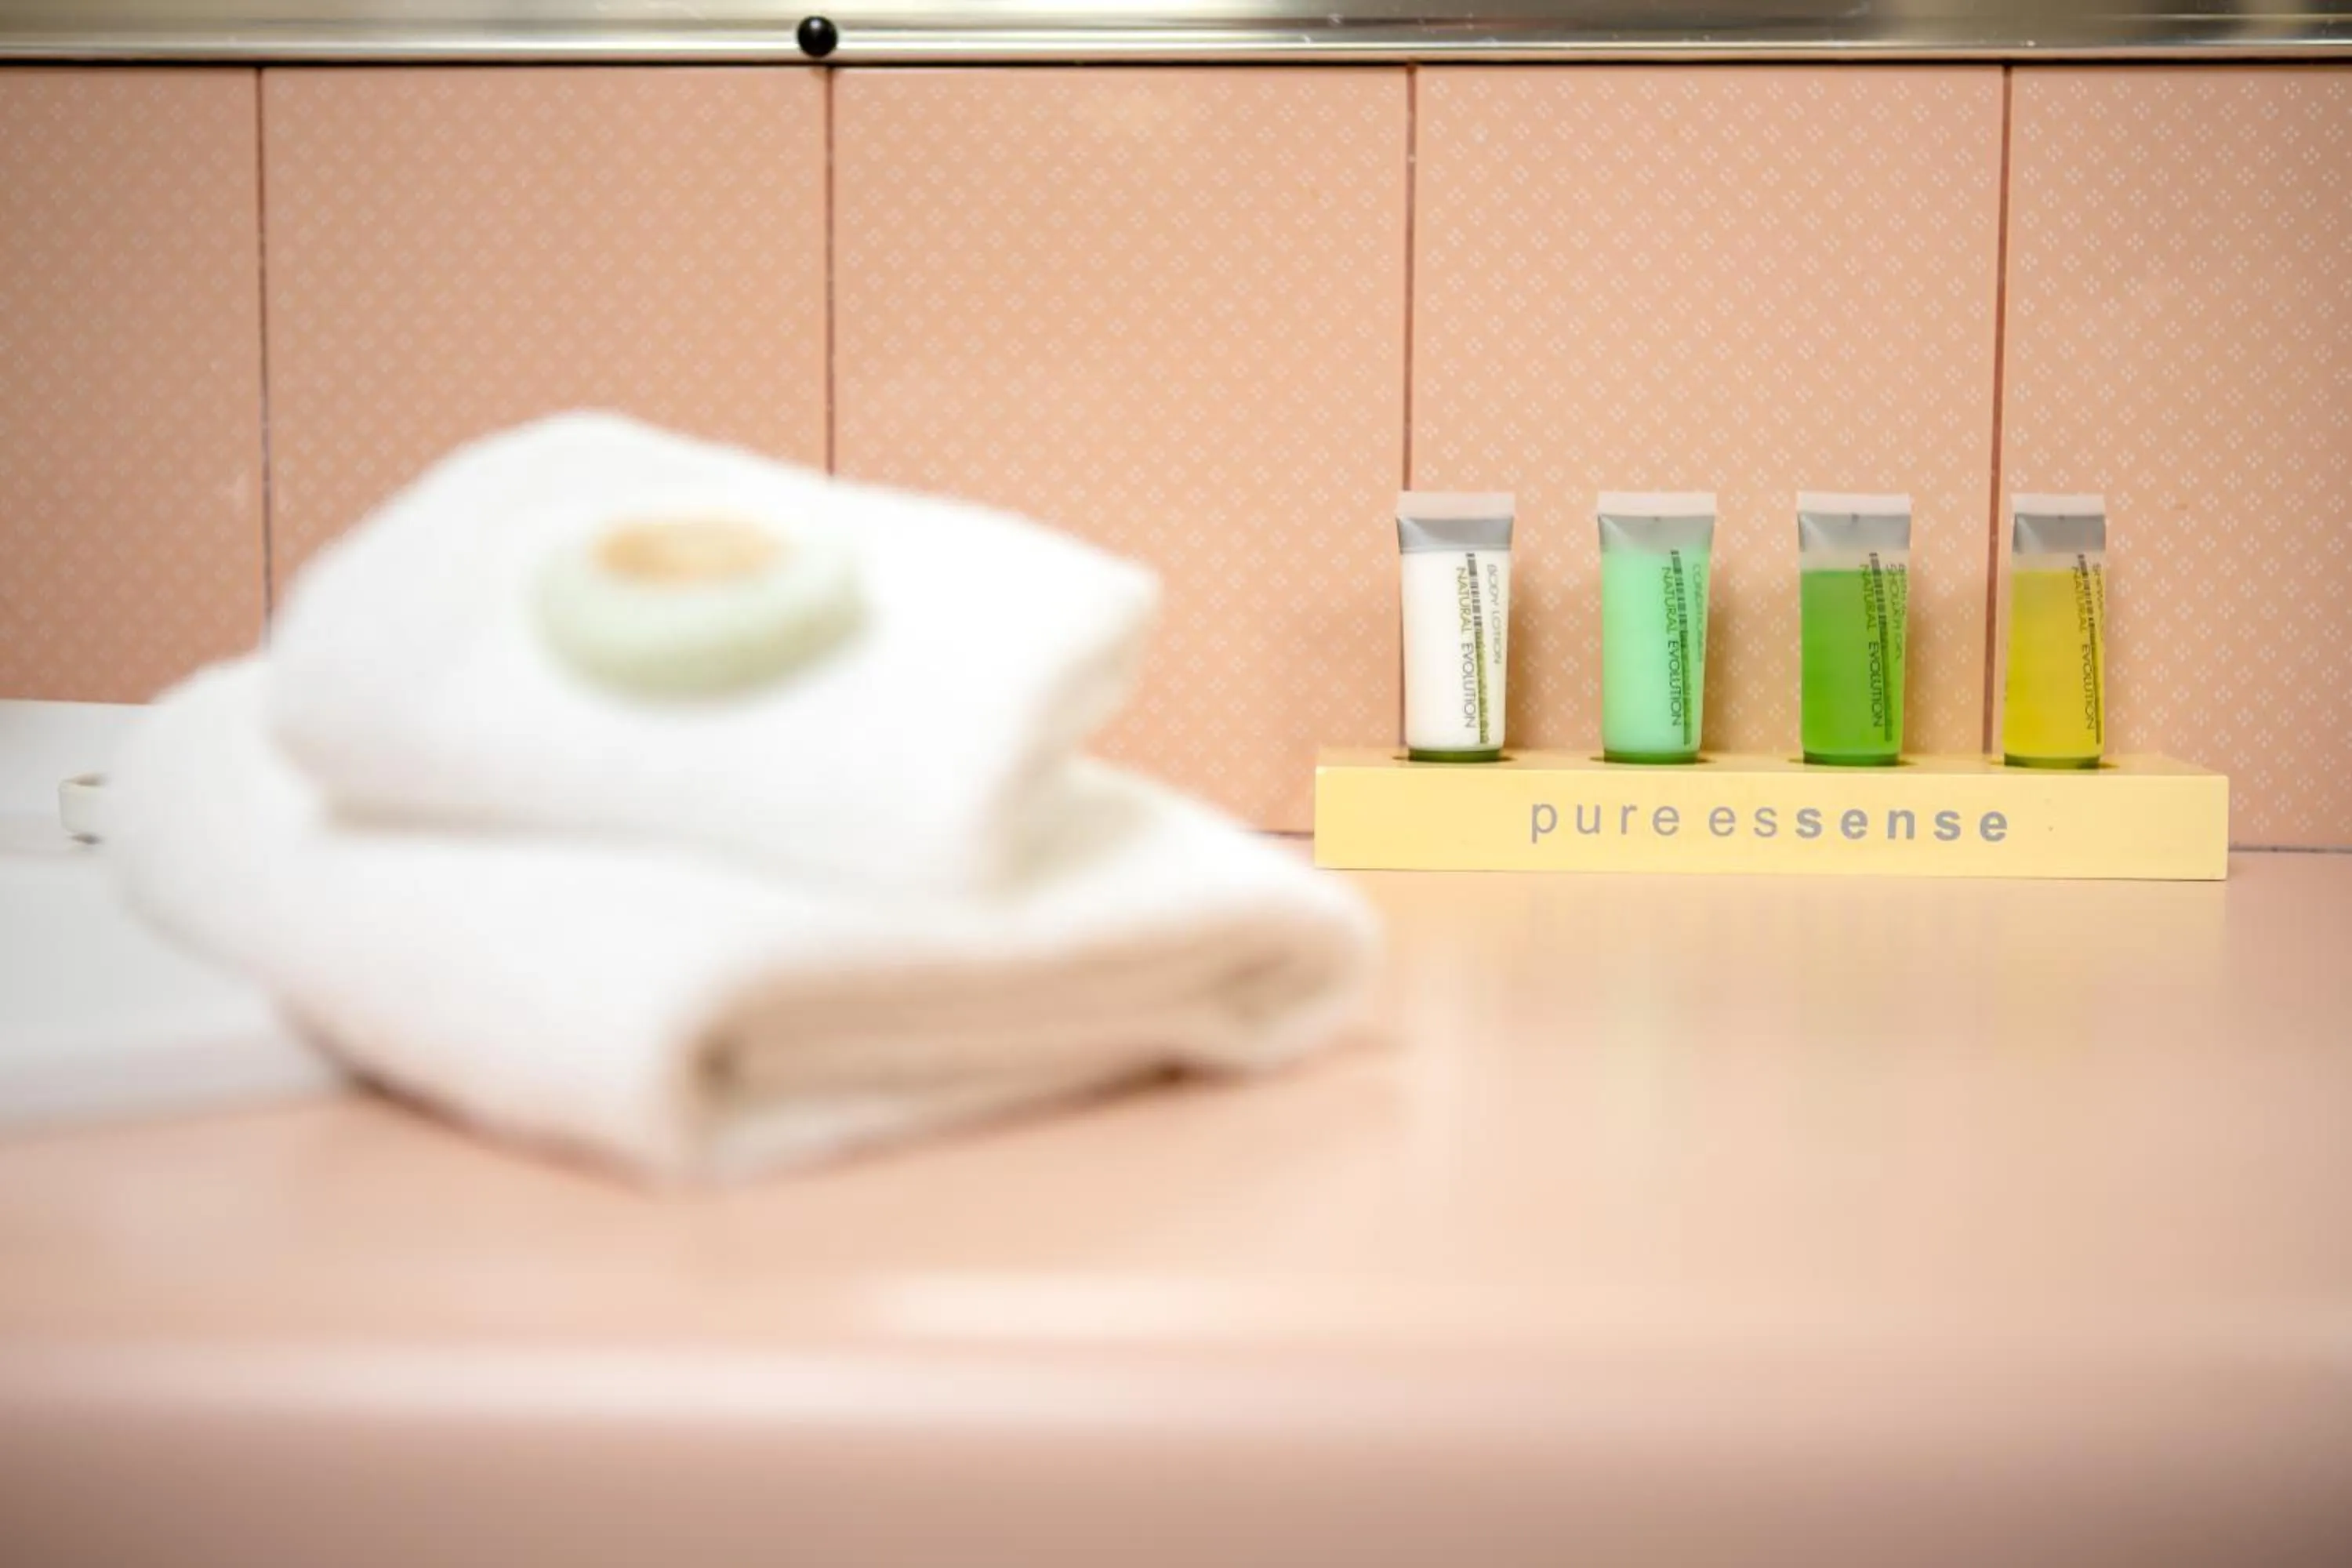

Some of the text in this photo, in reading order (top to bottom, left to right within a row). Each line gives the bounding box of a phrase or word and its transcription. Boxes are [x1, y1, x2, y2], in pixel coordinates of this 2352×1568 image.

[1456, 567, 1476, 728] NATURAL EVOLUTION
[1486, 564, 1502, 665] BODY LOTION
[1661, 566, 1682, 727] NATURAL EVOLUTION
[1860, 564, 1884, 728] NATURAL EVOLUTION
[2071, 566, 2096, 730] NATURAL EVOLUTION
[1530, 804, 2008, 843] pure essense
